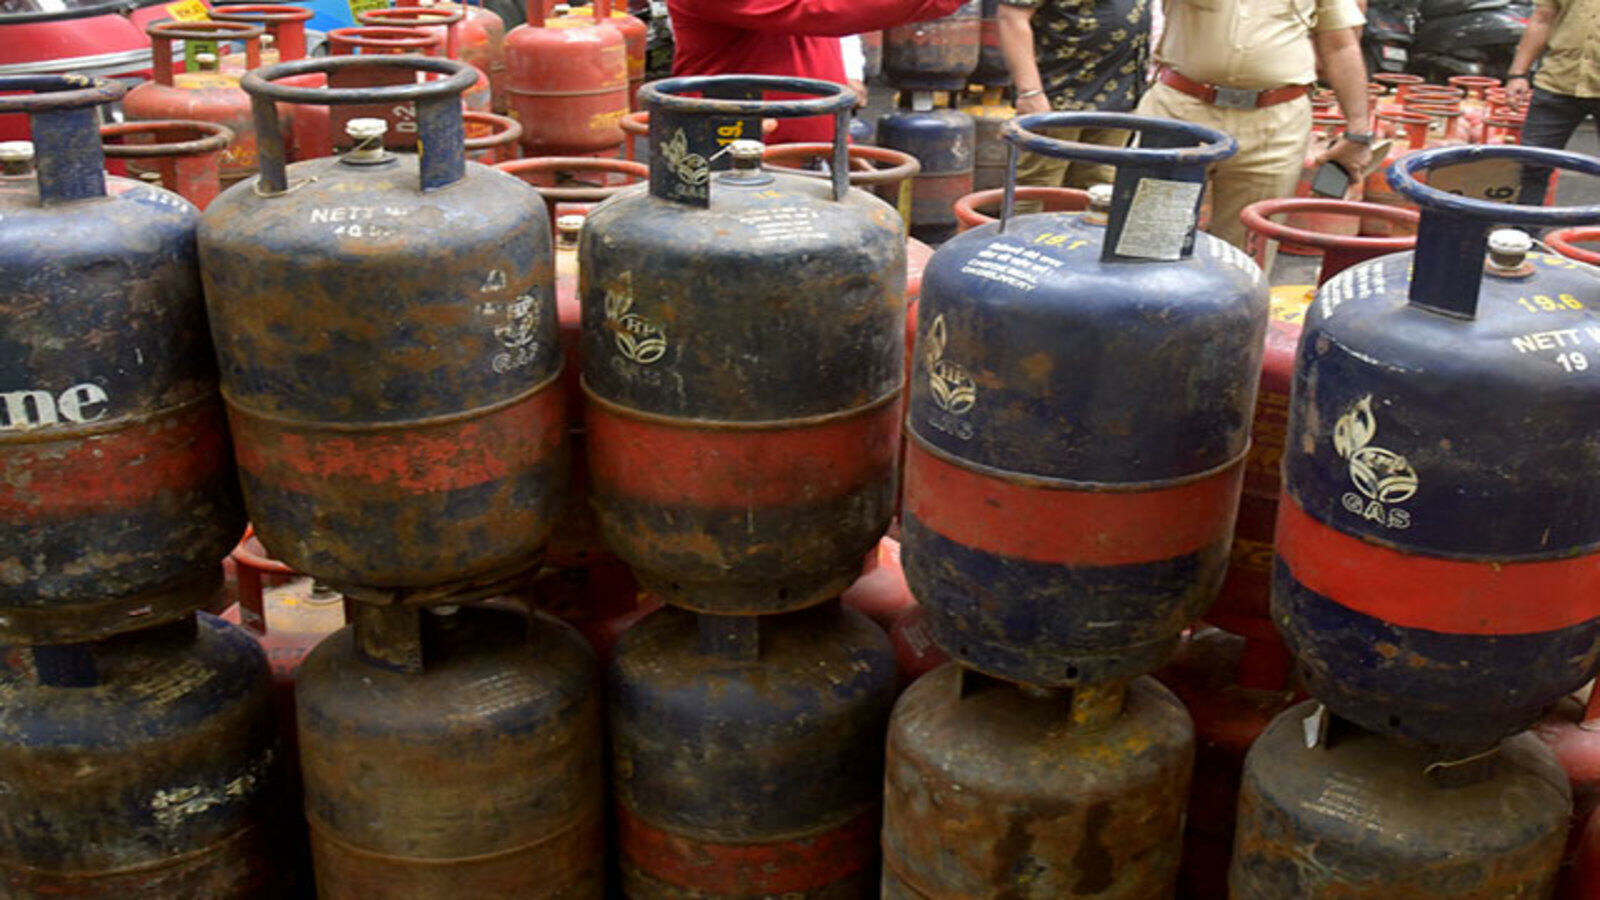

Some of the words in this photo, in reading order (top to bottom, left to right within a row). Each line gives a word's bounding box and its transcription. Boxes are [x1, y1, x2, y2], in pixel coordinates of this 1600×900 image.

[309, 206, 376, 223] NETT
[1511, 328, 1580, 353] NETT
[1556, 350, 1589, 372] 19
[1341, 491, 1412, 529] GAS
